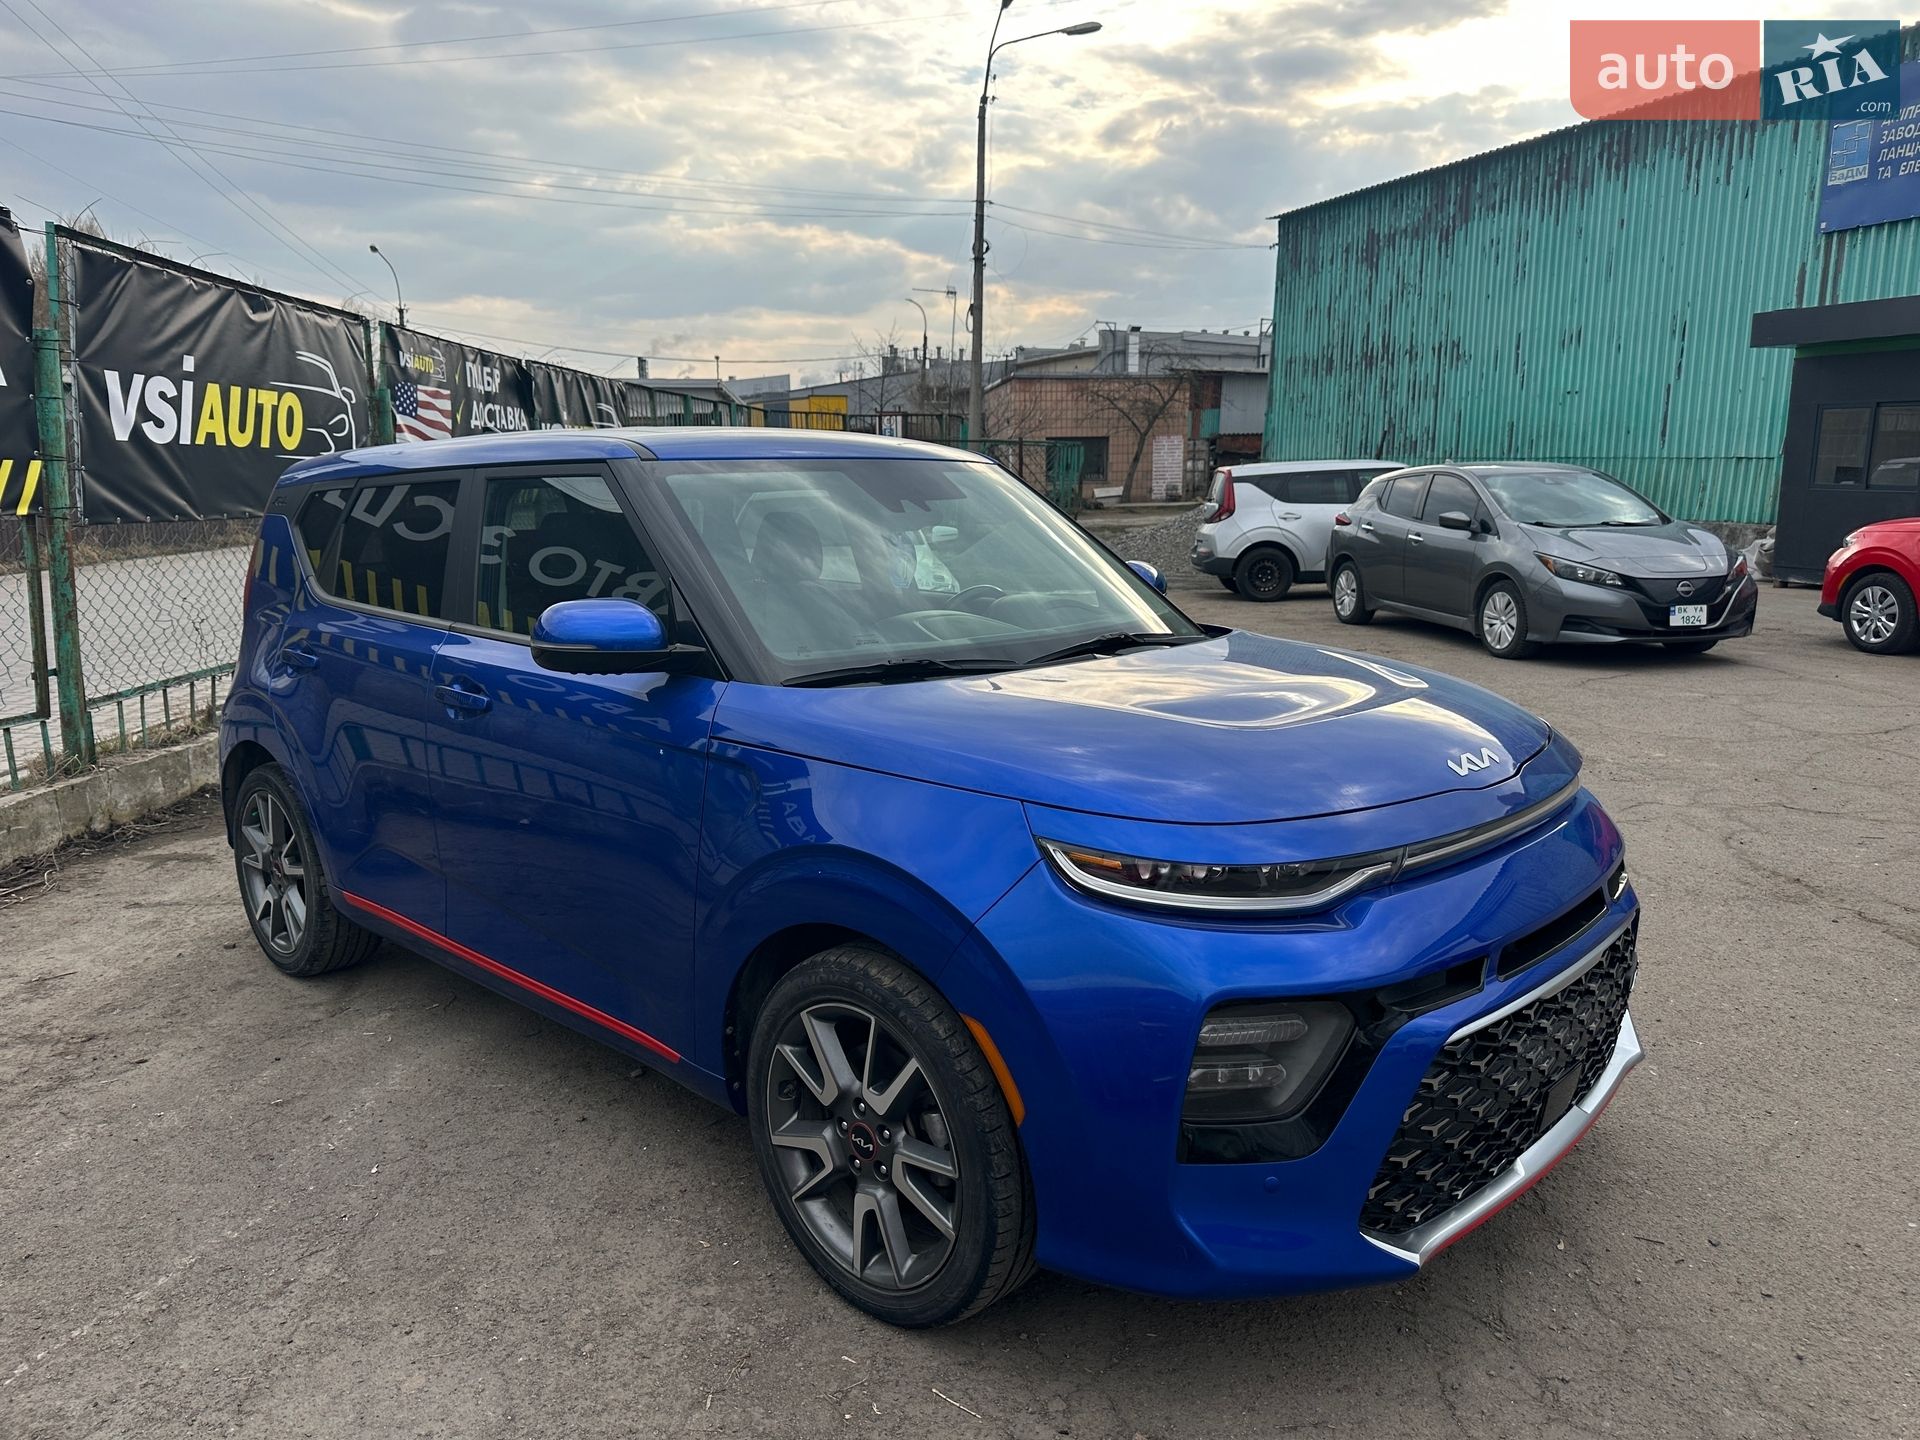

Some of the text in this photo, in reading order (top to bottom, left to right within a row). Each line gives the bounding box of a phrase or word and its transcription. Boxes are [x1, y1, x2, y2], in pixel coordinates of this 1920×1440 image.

[1877, 165, 1891, 180] ТА
[470, 400, 529, 431] ДОСТАВКА
[1680, 615, 1702, 624] 1824
